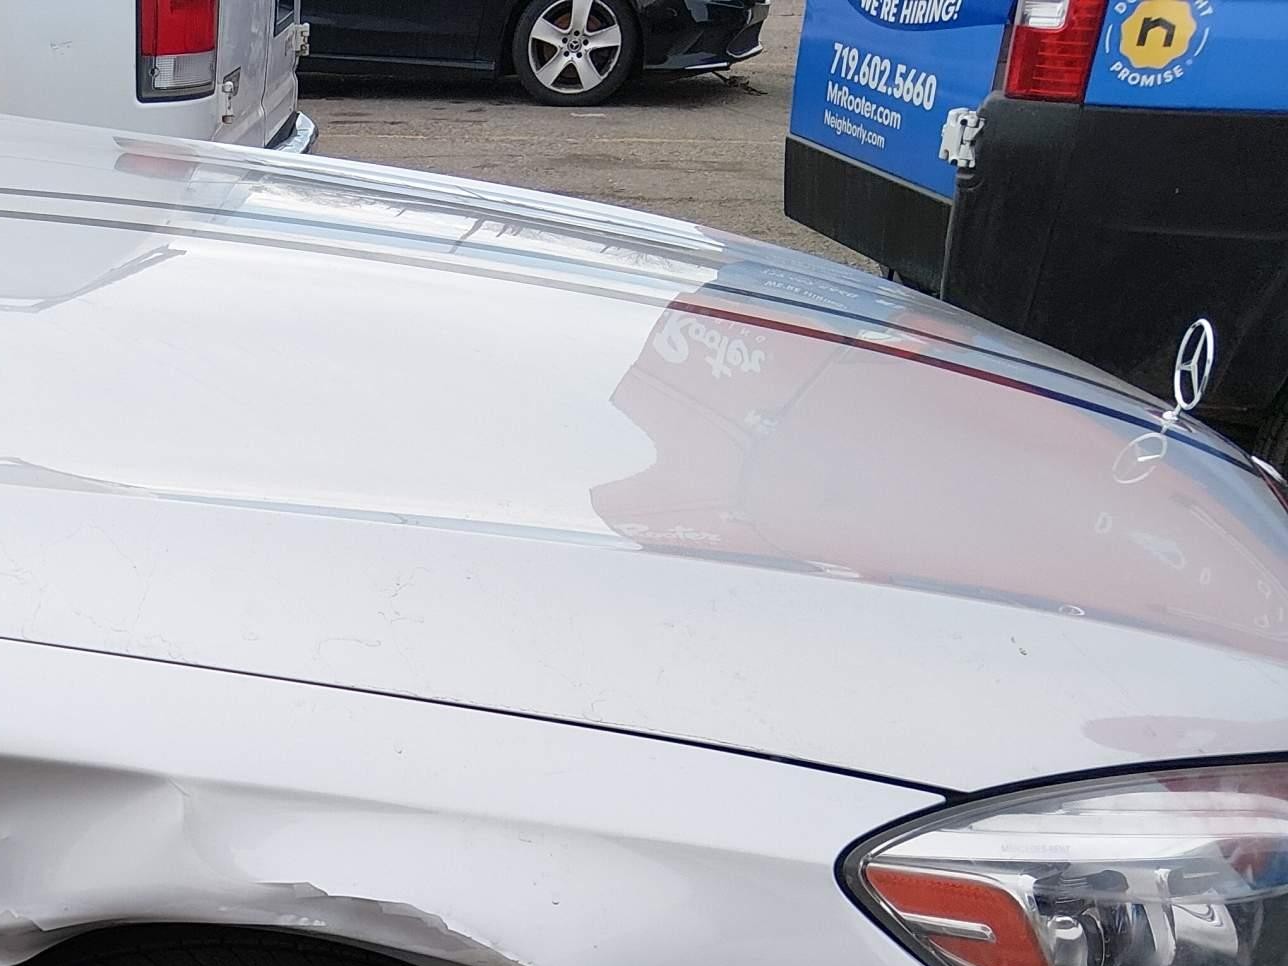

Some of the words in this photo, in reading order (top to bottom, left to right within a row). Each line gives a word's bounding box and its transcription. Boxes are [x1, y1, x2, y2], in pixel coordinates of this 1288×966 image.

[899, 0, 963, 24] HIRING!
[830, 42, 937, 111] 719.602.5660
[1110, 61, 1184, 87] PROMISE
[826, 80, 902, 130] MrRooter.com
[823, 109, 886, 149] Neighborly.com
